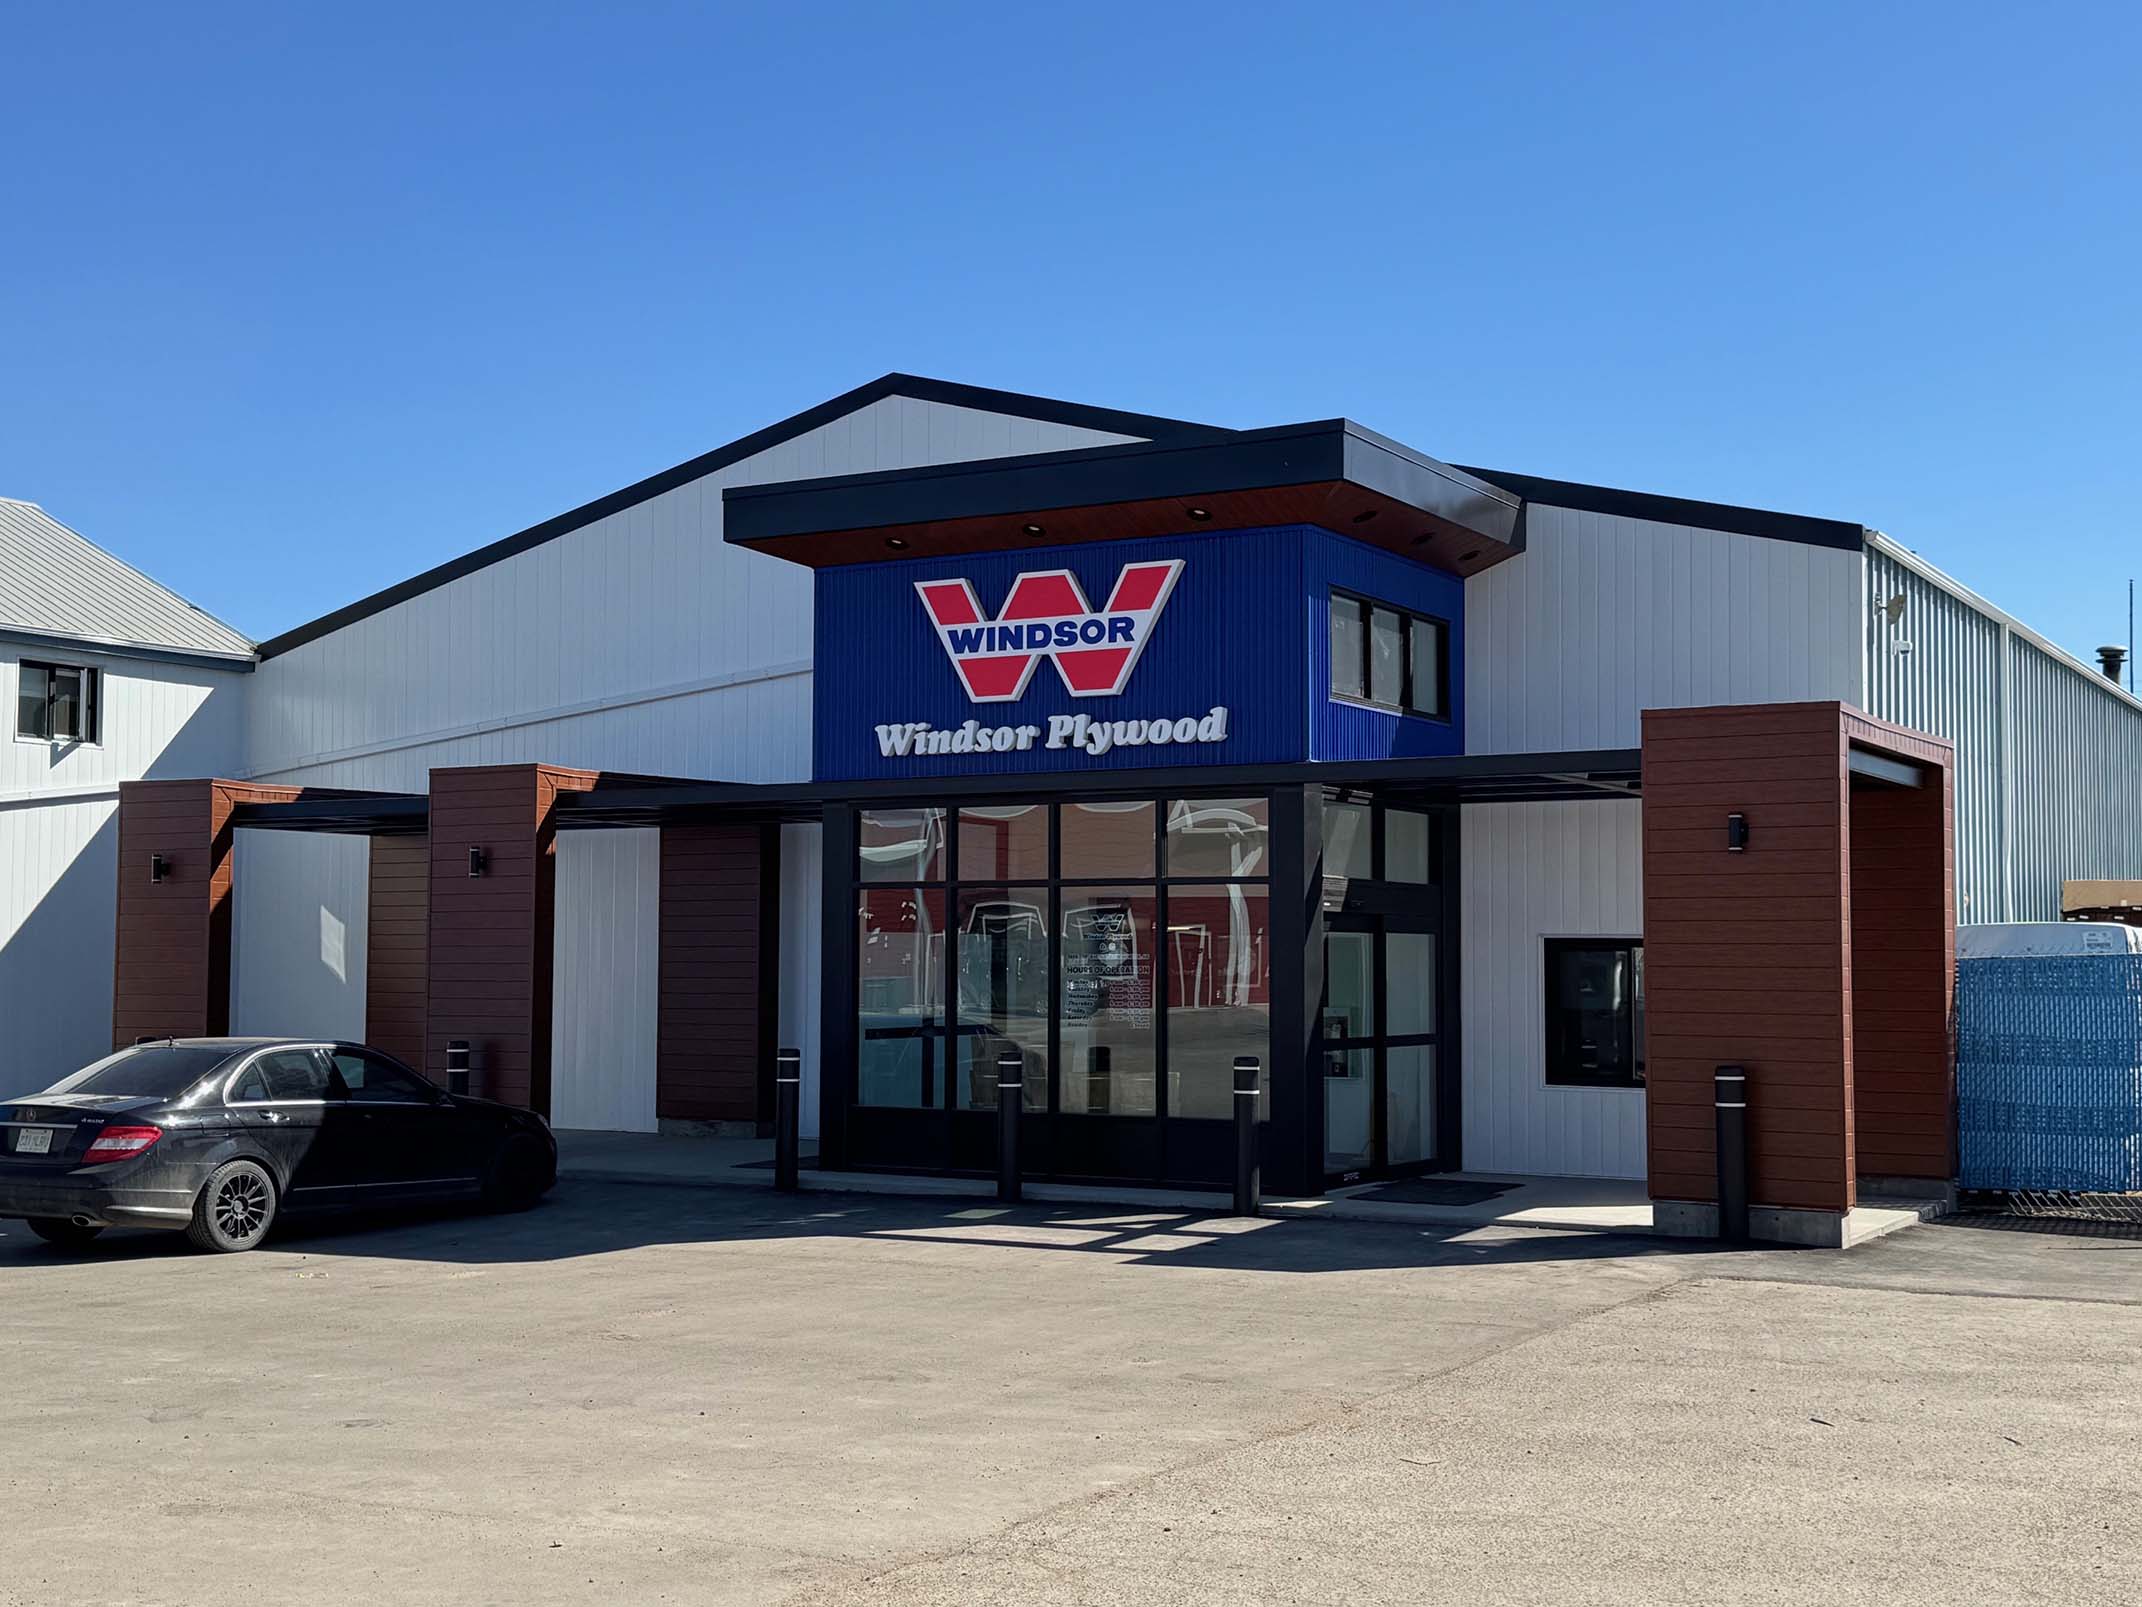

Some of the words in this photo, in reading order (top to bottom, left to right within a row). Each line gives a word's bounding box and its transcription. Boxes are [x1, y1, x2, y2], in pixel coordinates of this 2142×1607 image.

[947, 616, 1135, 654] WINDSOR
[874, 719, 1040, 757] Windsor
[1045, 706, 1229, 756] Plywood
